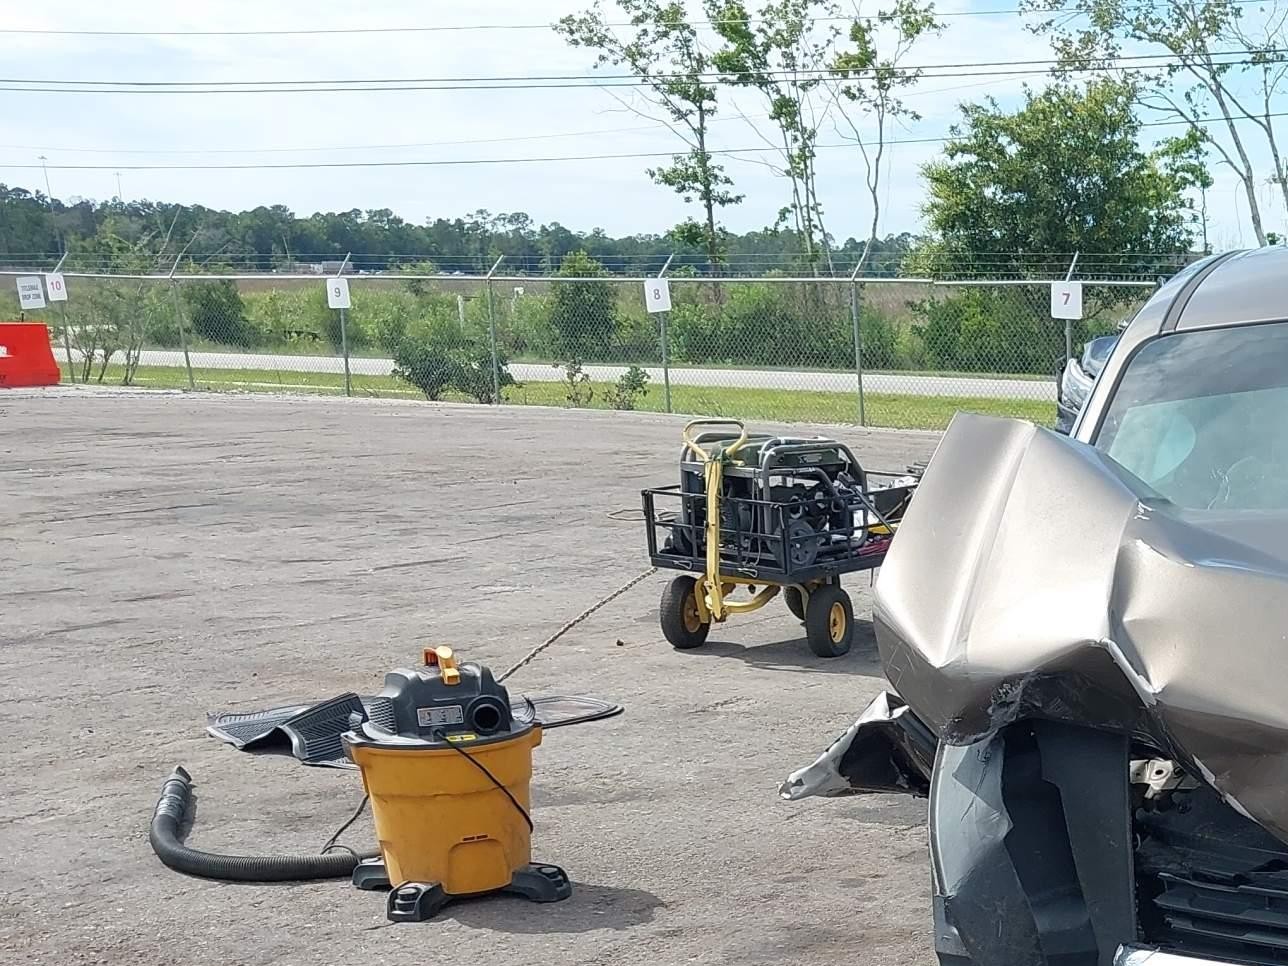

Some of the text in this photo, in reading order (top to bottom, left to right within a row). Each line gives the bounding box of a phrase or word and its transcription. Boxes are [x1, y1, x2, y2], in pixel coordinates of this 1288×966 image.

[50, 281, 62, 292] 10
[335, 287, 341, 298] 9
[653, 288, 661, 300] 8
[1062, 293, 1071, 306] 7
